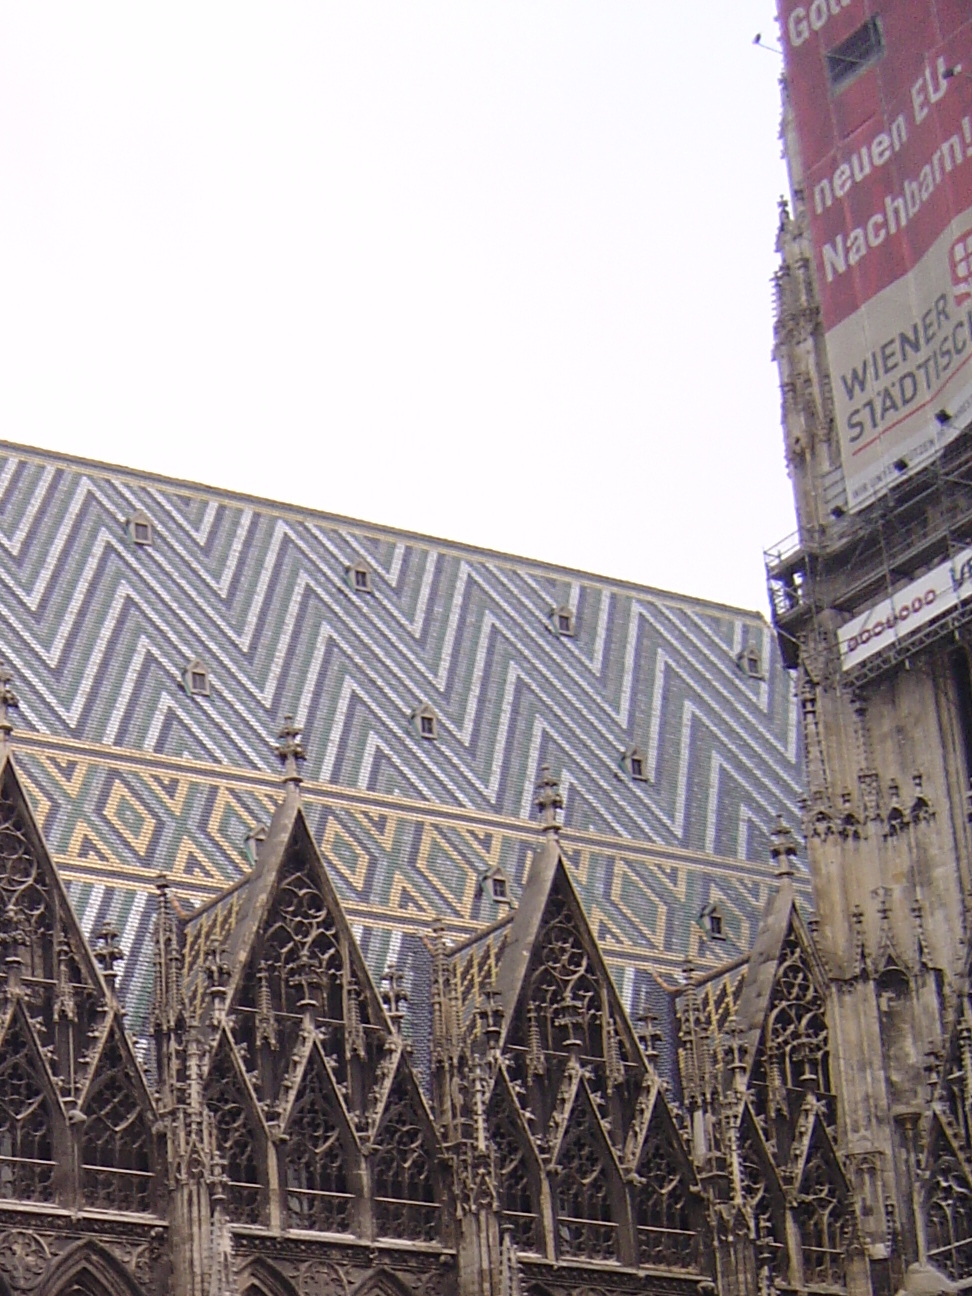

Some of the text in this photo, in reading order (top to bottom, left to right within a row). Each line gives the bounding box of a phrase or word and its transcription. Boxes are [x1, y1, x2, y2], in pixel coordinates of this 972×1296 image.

[814, 114, 907, 214] neuen
[822, 116, 972, 282] Nachbarn!
[841, 293, 950, 401] WIENER
